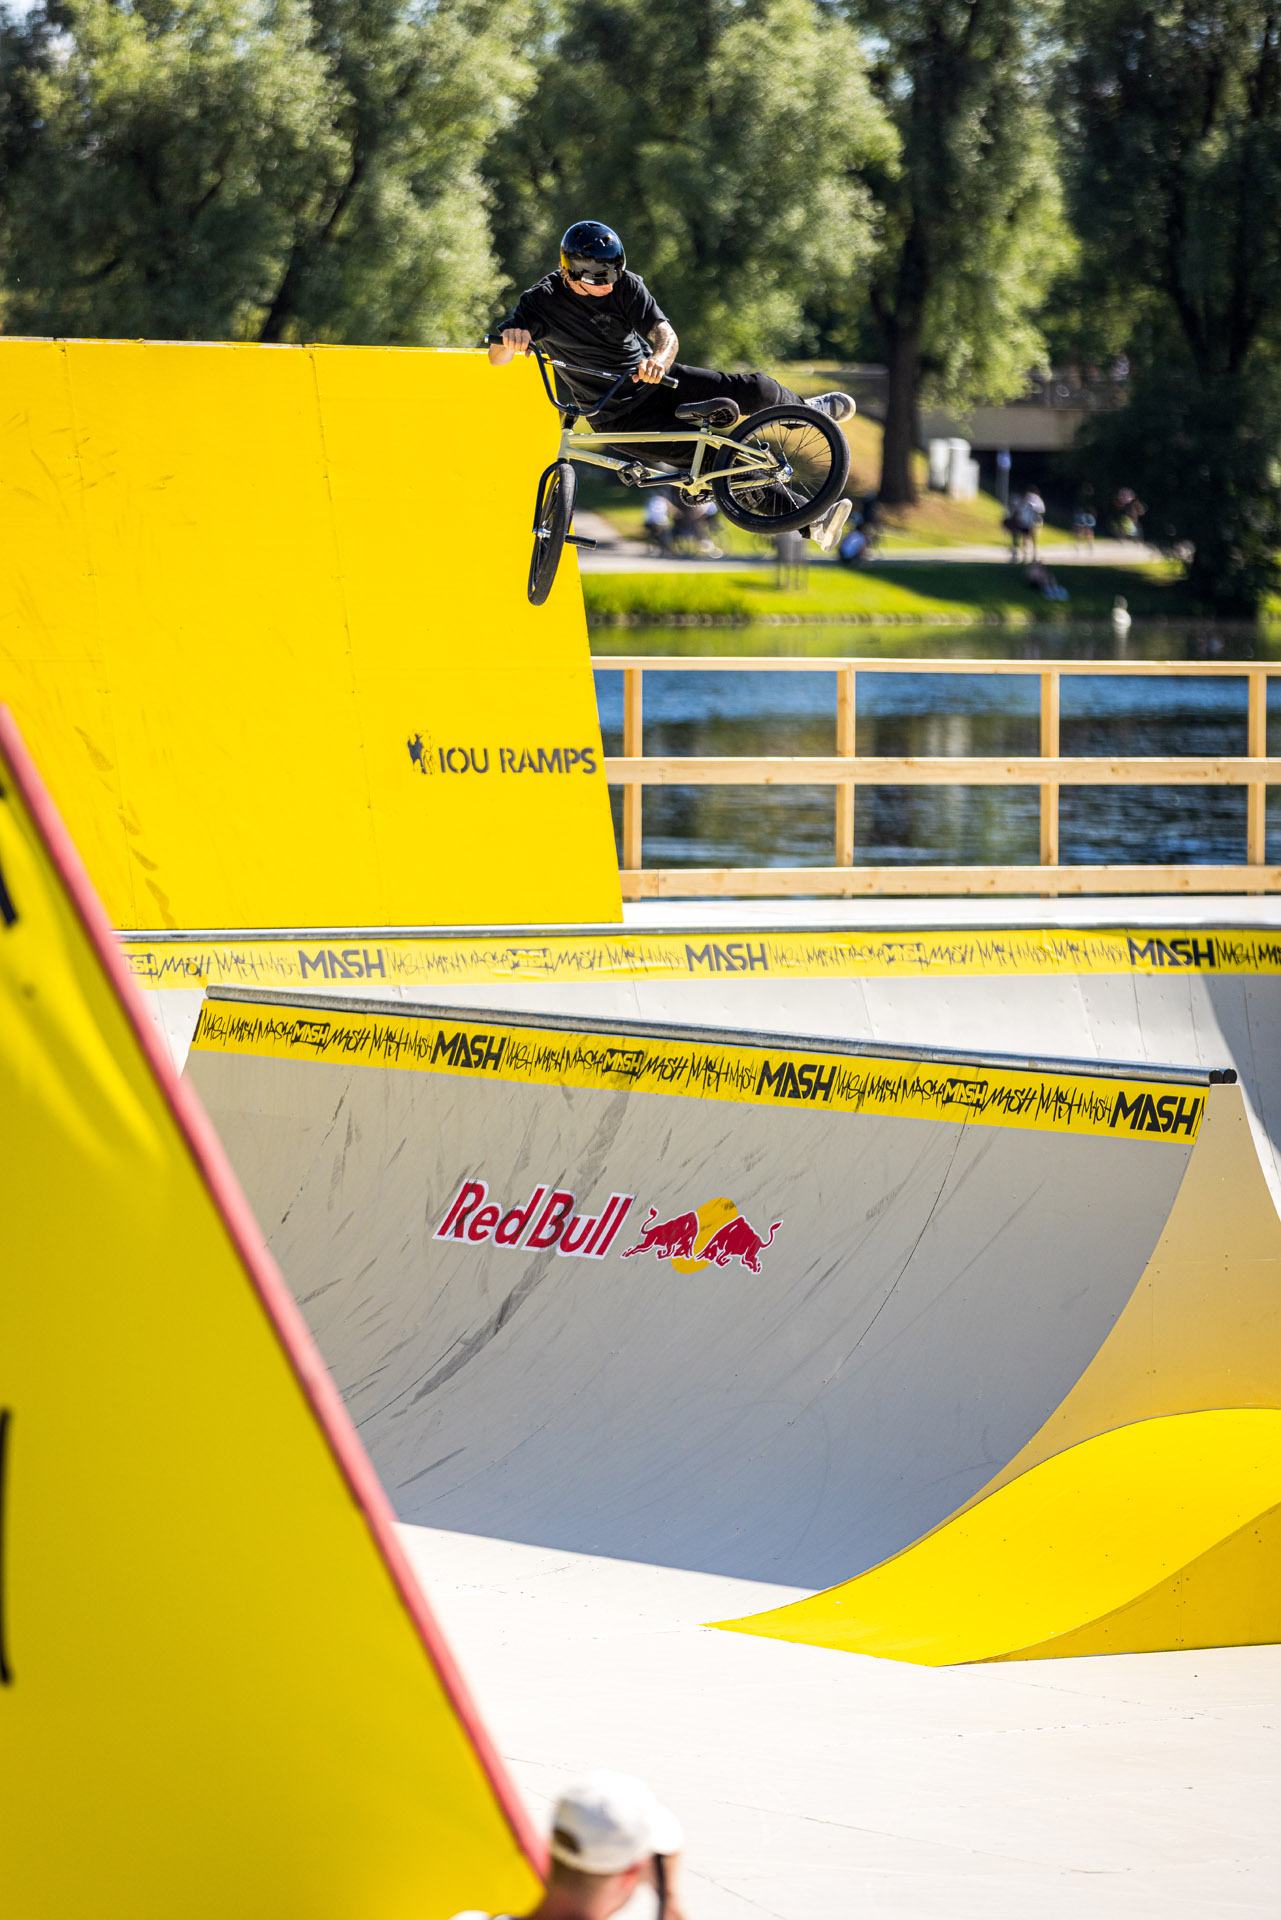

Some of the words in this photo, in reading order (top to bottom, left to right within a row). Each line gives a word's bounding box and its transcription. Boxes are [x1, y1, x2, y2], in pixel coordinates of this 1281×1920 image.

[438, 747, 489, 774] IOU
[500, 747, 597, 775] RAMPS
[298, 949, 386, 979] MASH
[685, 943, 769, 972] MASH
[1127, 937, 1216, 967] MASH
[292, 1020, 331, 1050] MASH
[324, 1027, 372, 1055] MASH
[430, 1030, 507, 1070] MASH
[602, 1048, 645, 1080] MASH
[636, 1055, 689, 1083] MASH
[755, 1060, 837, 1100] MASH
[942, 1078, 989, 1112] MASH
[982, 1086, 1037, 1114] MASH
[1109, 1091, 1200, 1135] MASH
[434, 1179, 548, 1247] Red
[523, 1190, 637, 1259] Bull
